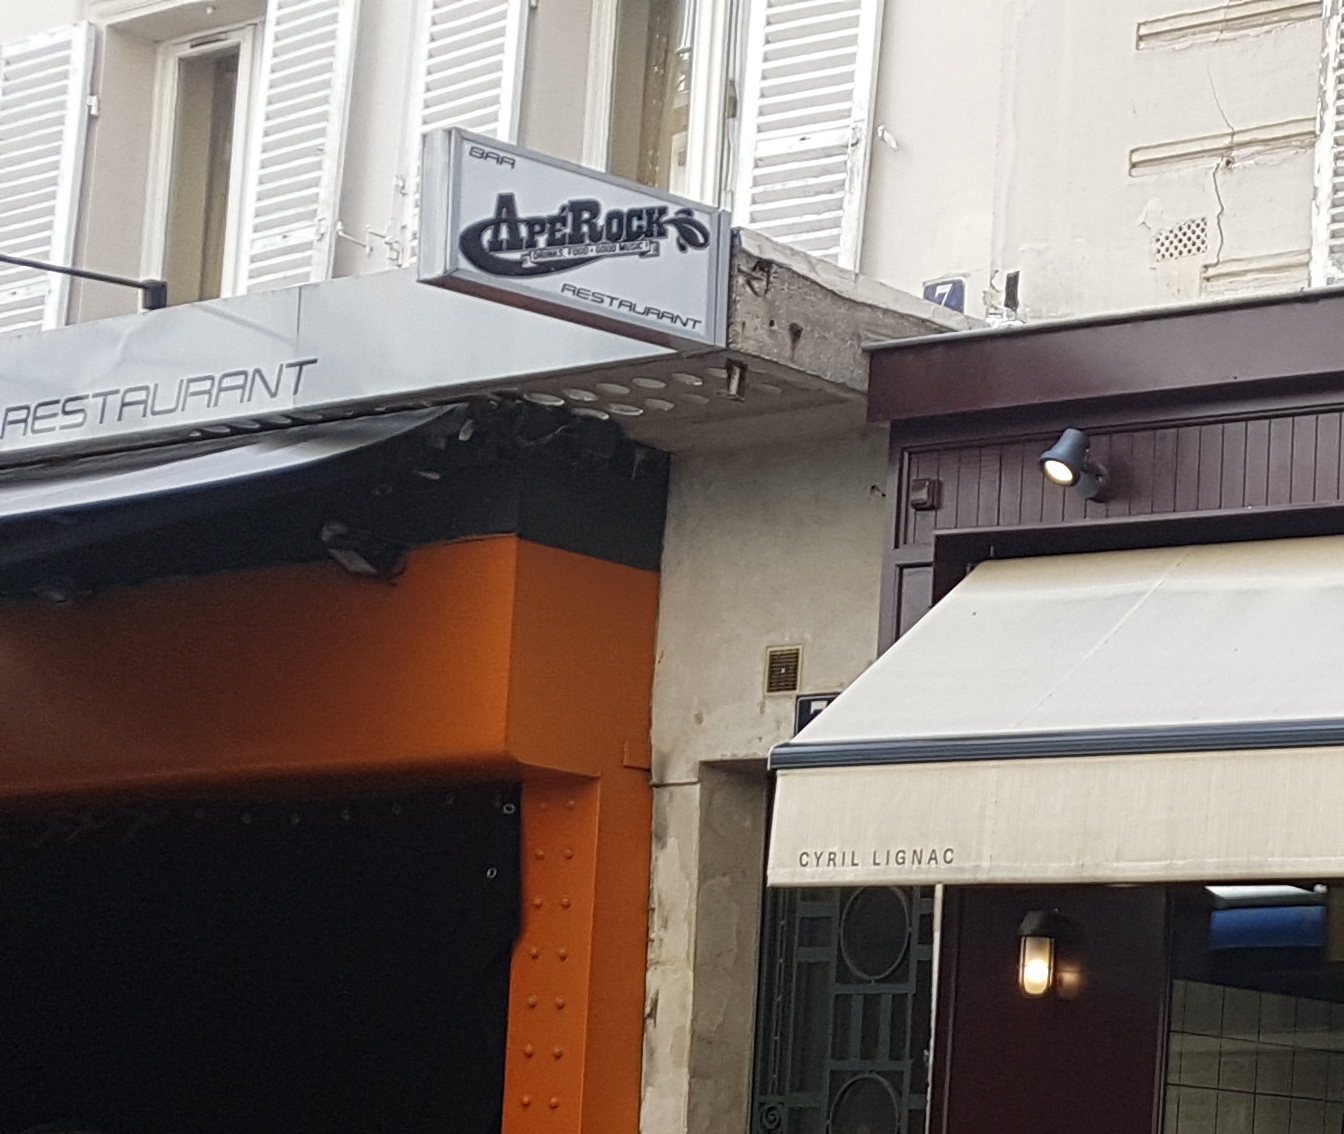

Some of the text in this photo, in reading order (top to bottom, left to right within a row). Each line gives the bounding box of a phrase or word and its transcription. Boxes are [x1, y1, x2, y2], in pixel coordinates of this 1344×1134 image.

[468, 146, 516, 169] BAR
[561, 283, 703, 330] RESTAURANT
[0, 357, 318, 440] RESTAURANT
[798, 848, 955, 868] CYRIL LIGNAC
